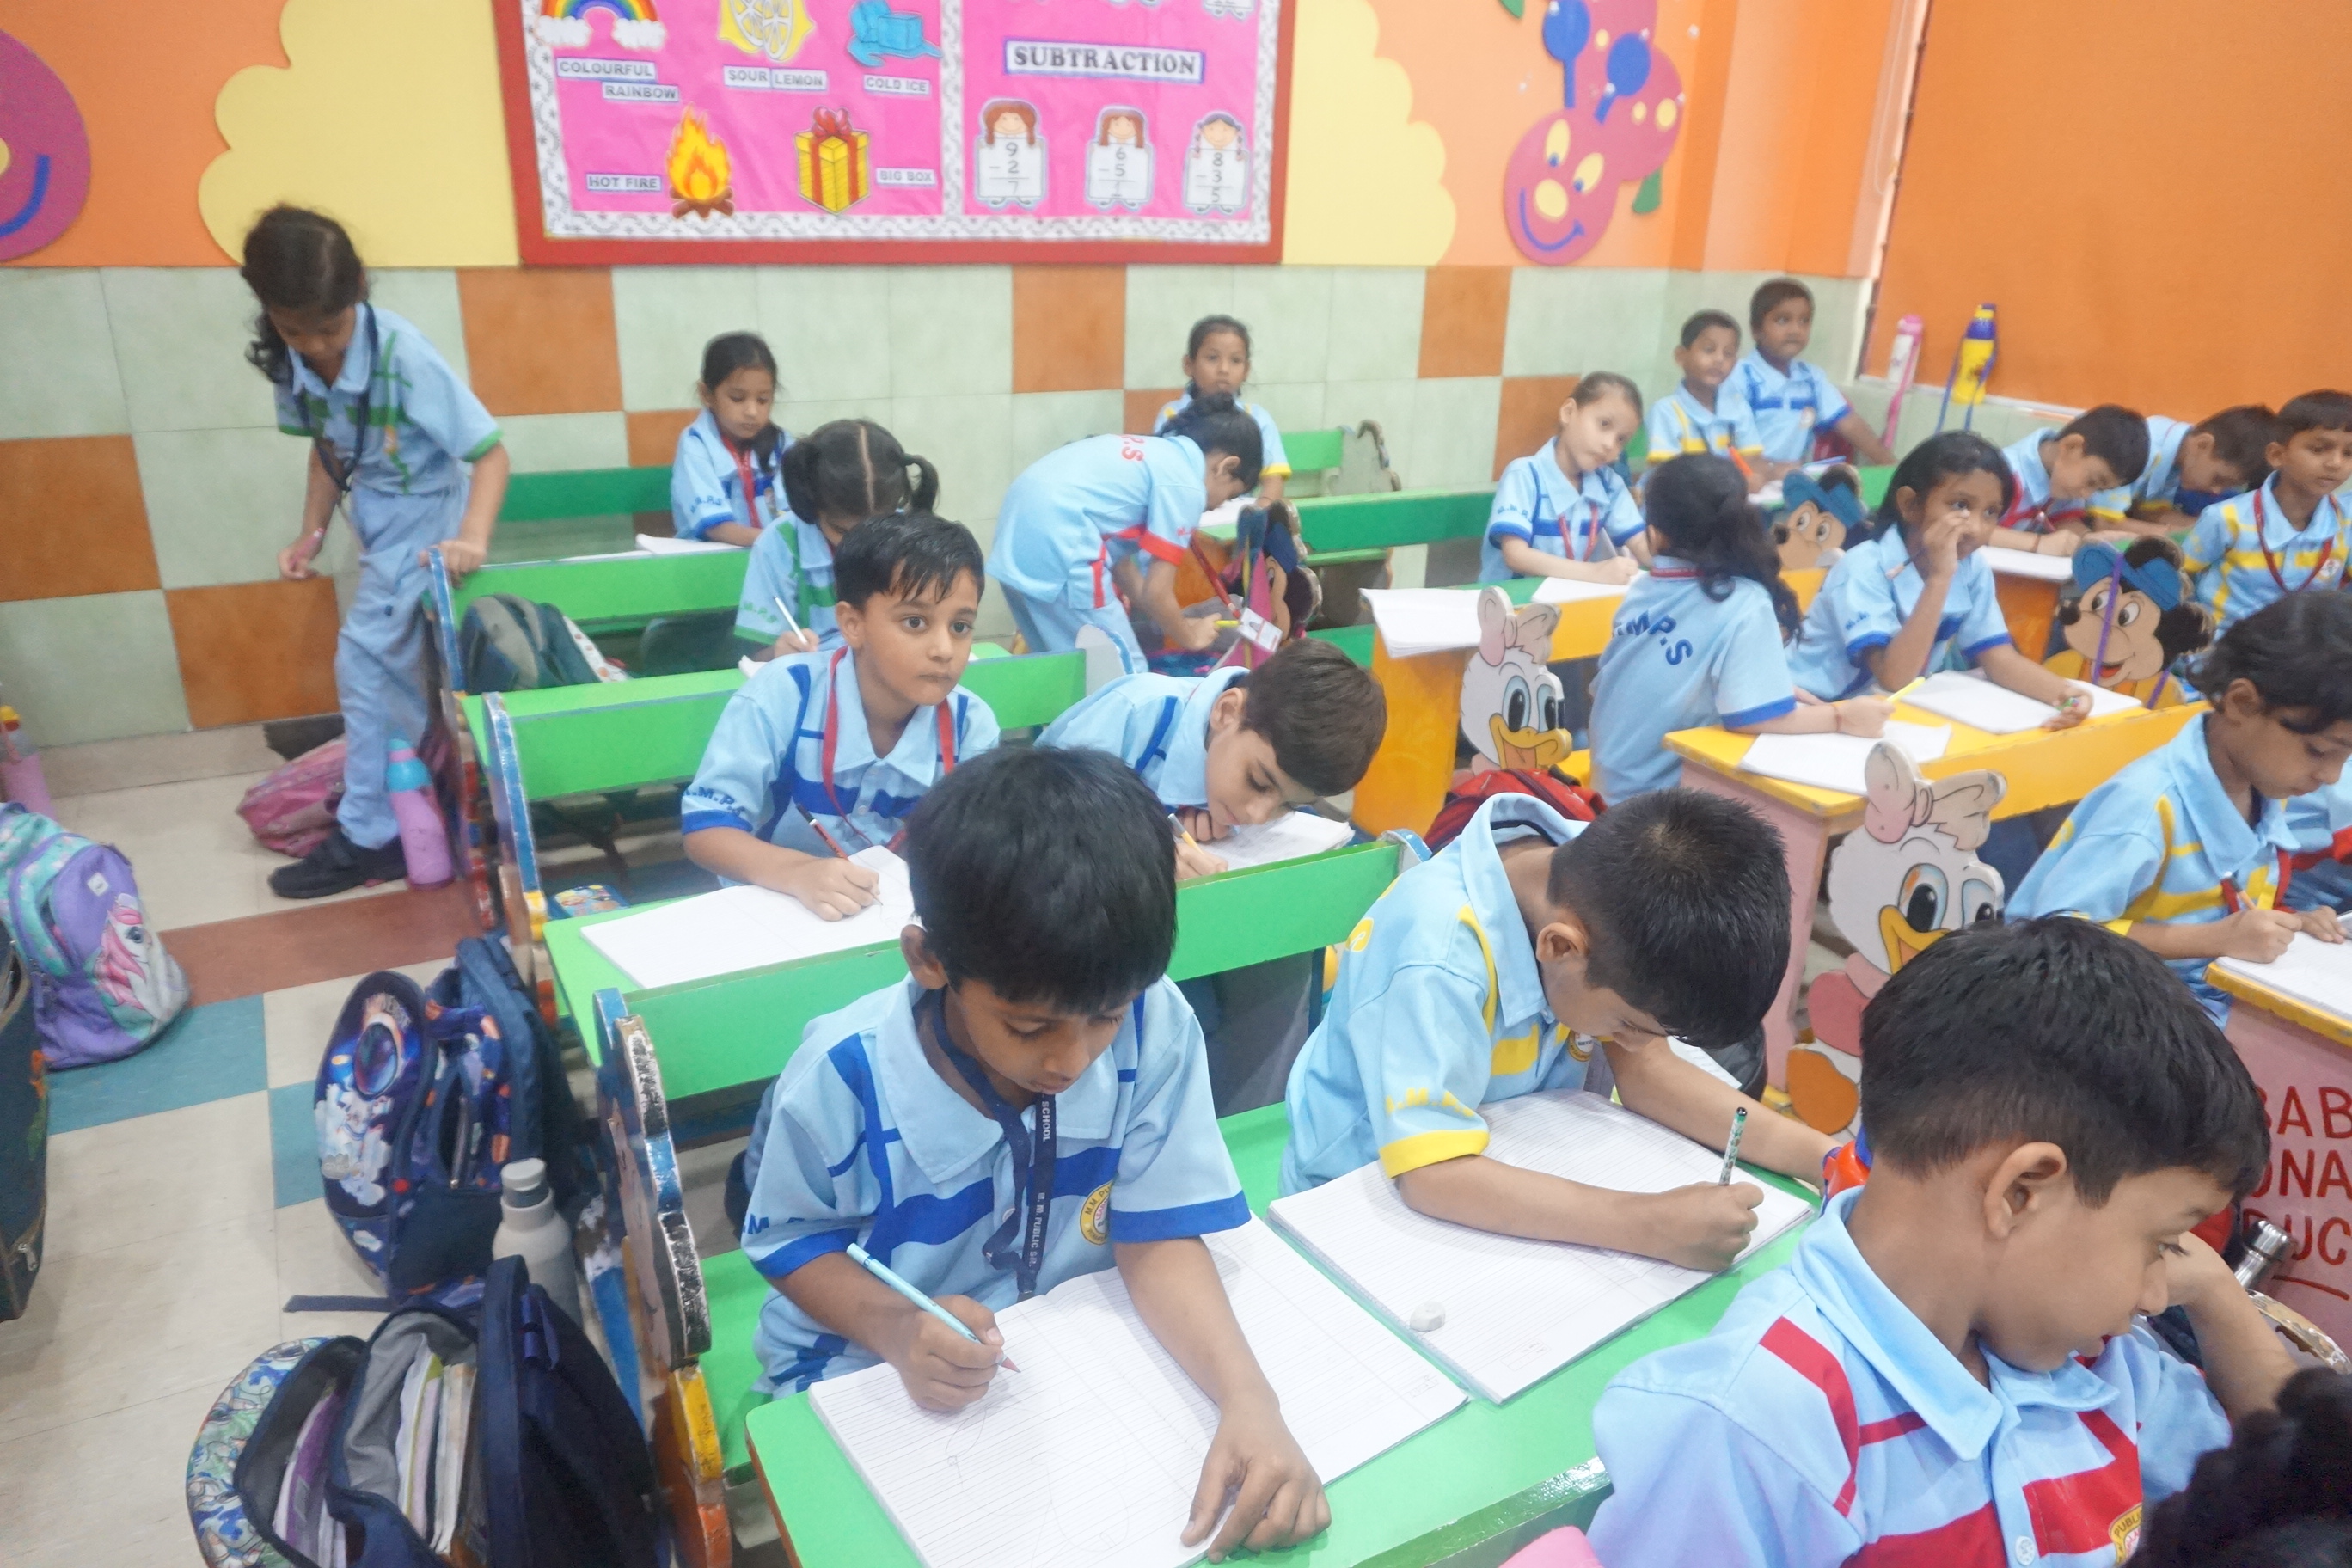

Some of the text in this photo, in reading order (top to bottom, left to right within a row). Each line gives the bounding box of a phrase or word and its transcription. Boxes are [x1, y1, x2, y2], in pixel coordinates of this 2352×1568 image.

[1014, 46, 1196, 75] SUBTRACTION
[560, 61, 652, 77] COLOURFUL
[728, 70, 824, 86] SOUR LEMON
[866, 77, 927, 92] COLD ICE
[605, 85, 676, 99] RAINBOW
[1006, 142, 1018, 157] 9
[1116, 147, 1126, 161] 6
[1212, 152, 1223, 167] 8
[1008, 160, 1020, 175] 2
[1114, 163, 1126, 177] 5
[589, 176, 657, 188] HOT FIRE
[880, 170, 932, 181] BIG BOX
[1212, 169, 1222, 183] 3
[1008, 180, 1019, 195] 7
[2256, 1085, 2352, 1139] AB
[1041, 1100, 1051, 1142] SCHOOL
[1031, 1216, 1043, 1249] PUBLIC
